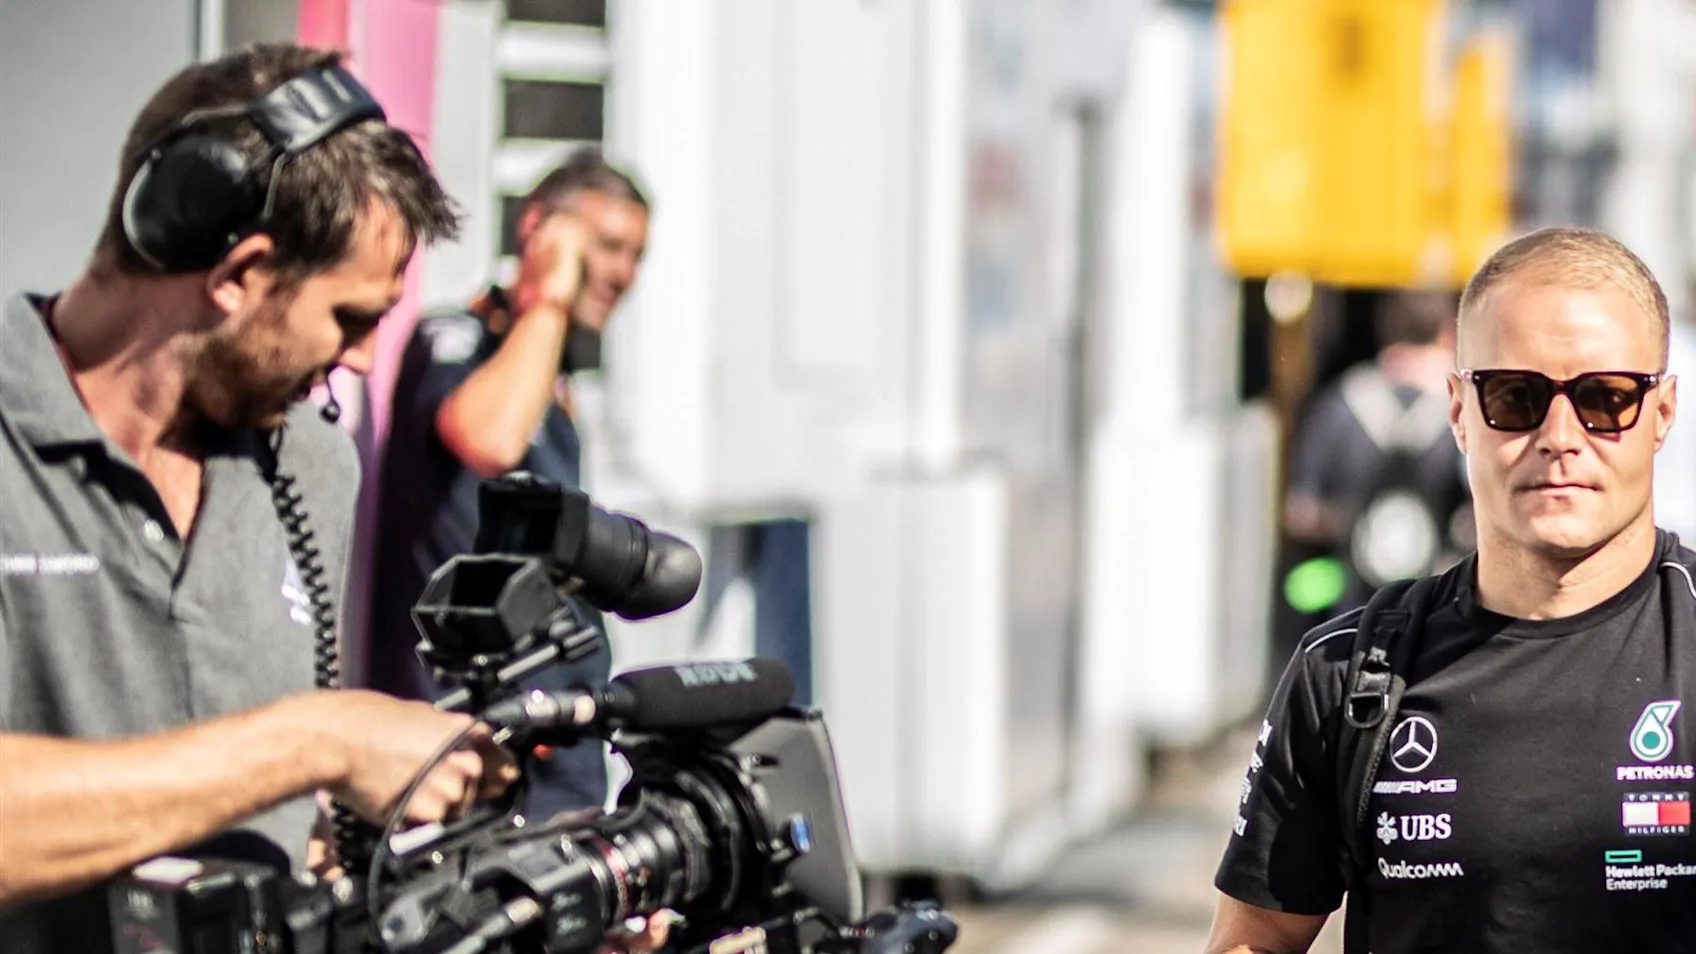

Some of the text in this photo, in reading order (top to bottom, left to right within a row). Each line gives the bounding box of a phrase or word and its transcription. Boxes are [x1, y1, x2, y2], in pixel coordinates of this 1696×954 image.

[1616, 765, 1695, 781] PETRONAS
[1396, 779, 1458, 794] AMG
[1628, 793, 1685, 802] TOMMY
[1400, 813, 1452, 841] UBS
[1628, 826, 1685, 834] HILFIGER
[1378, 857, 1464, 879] Qualcomm
[1605, 865, 1655, 878] Hewlett
[1606, 878, 1668, 891] Enterprise
